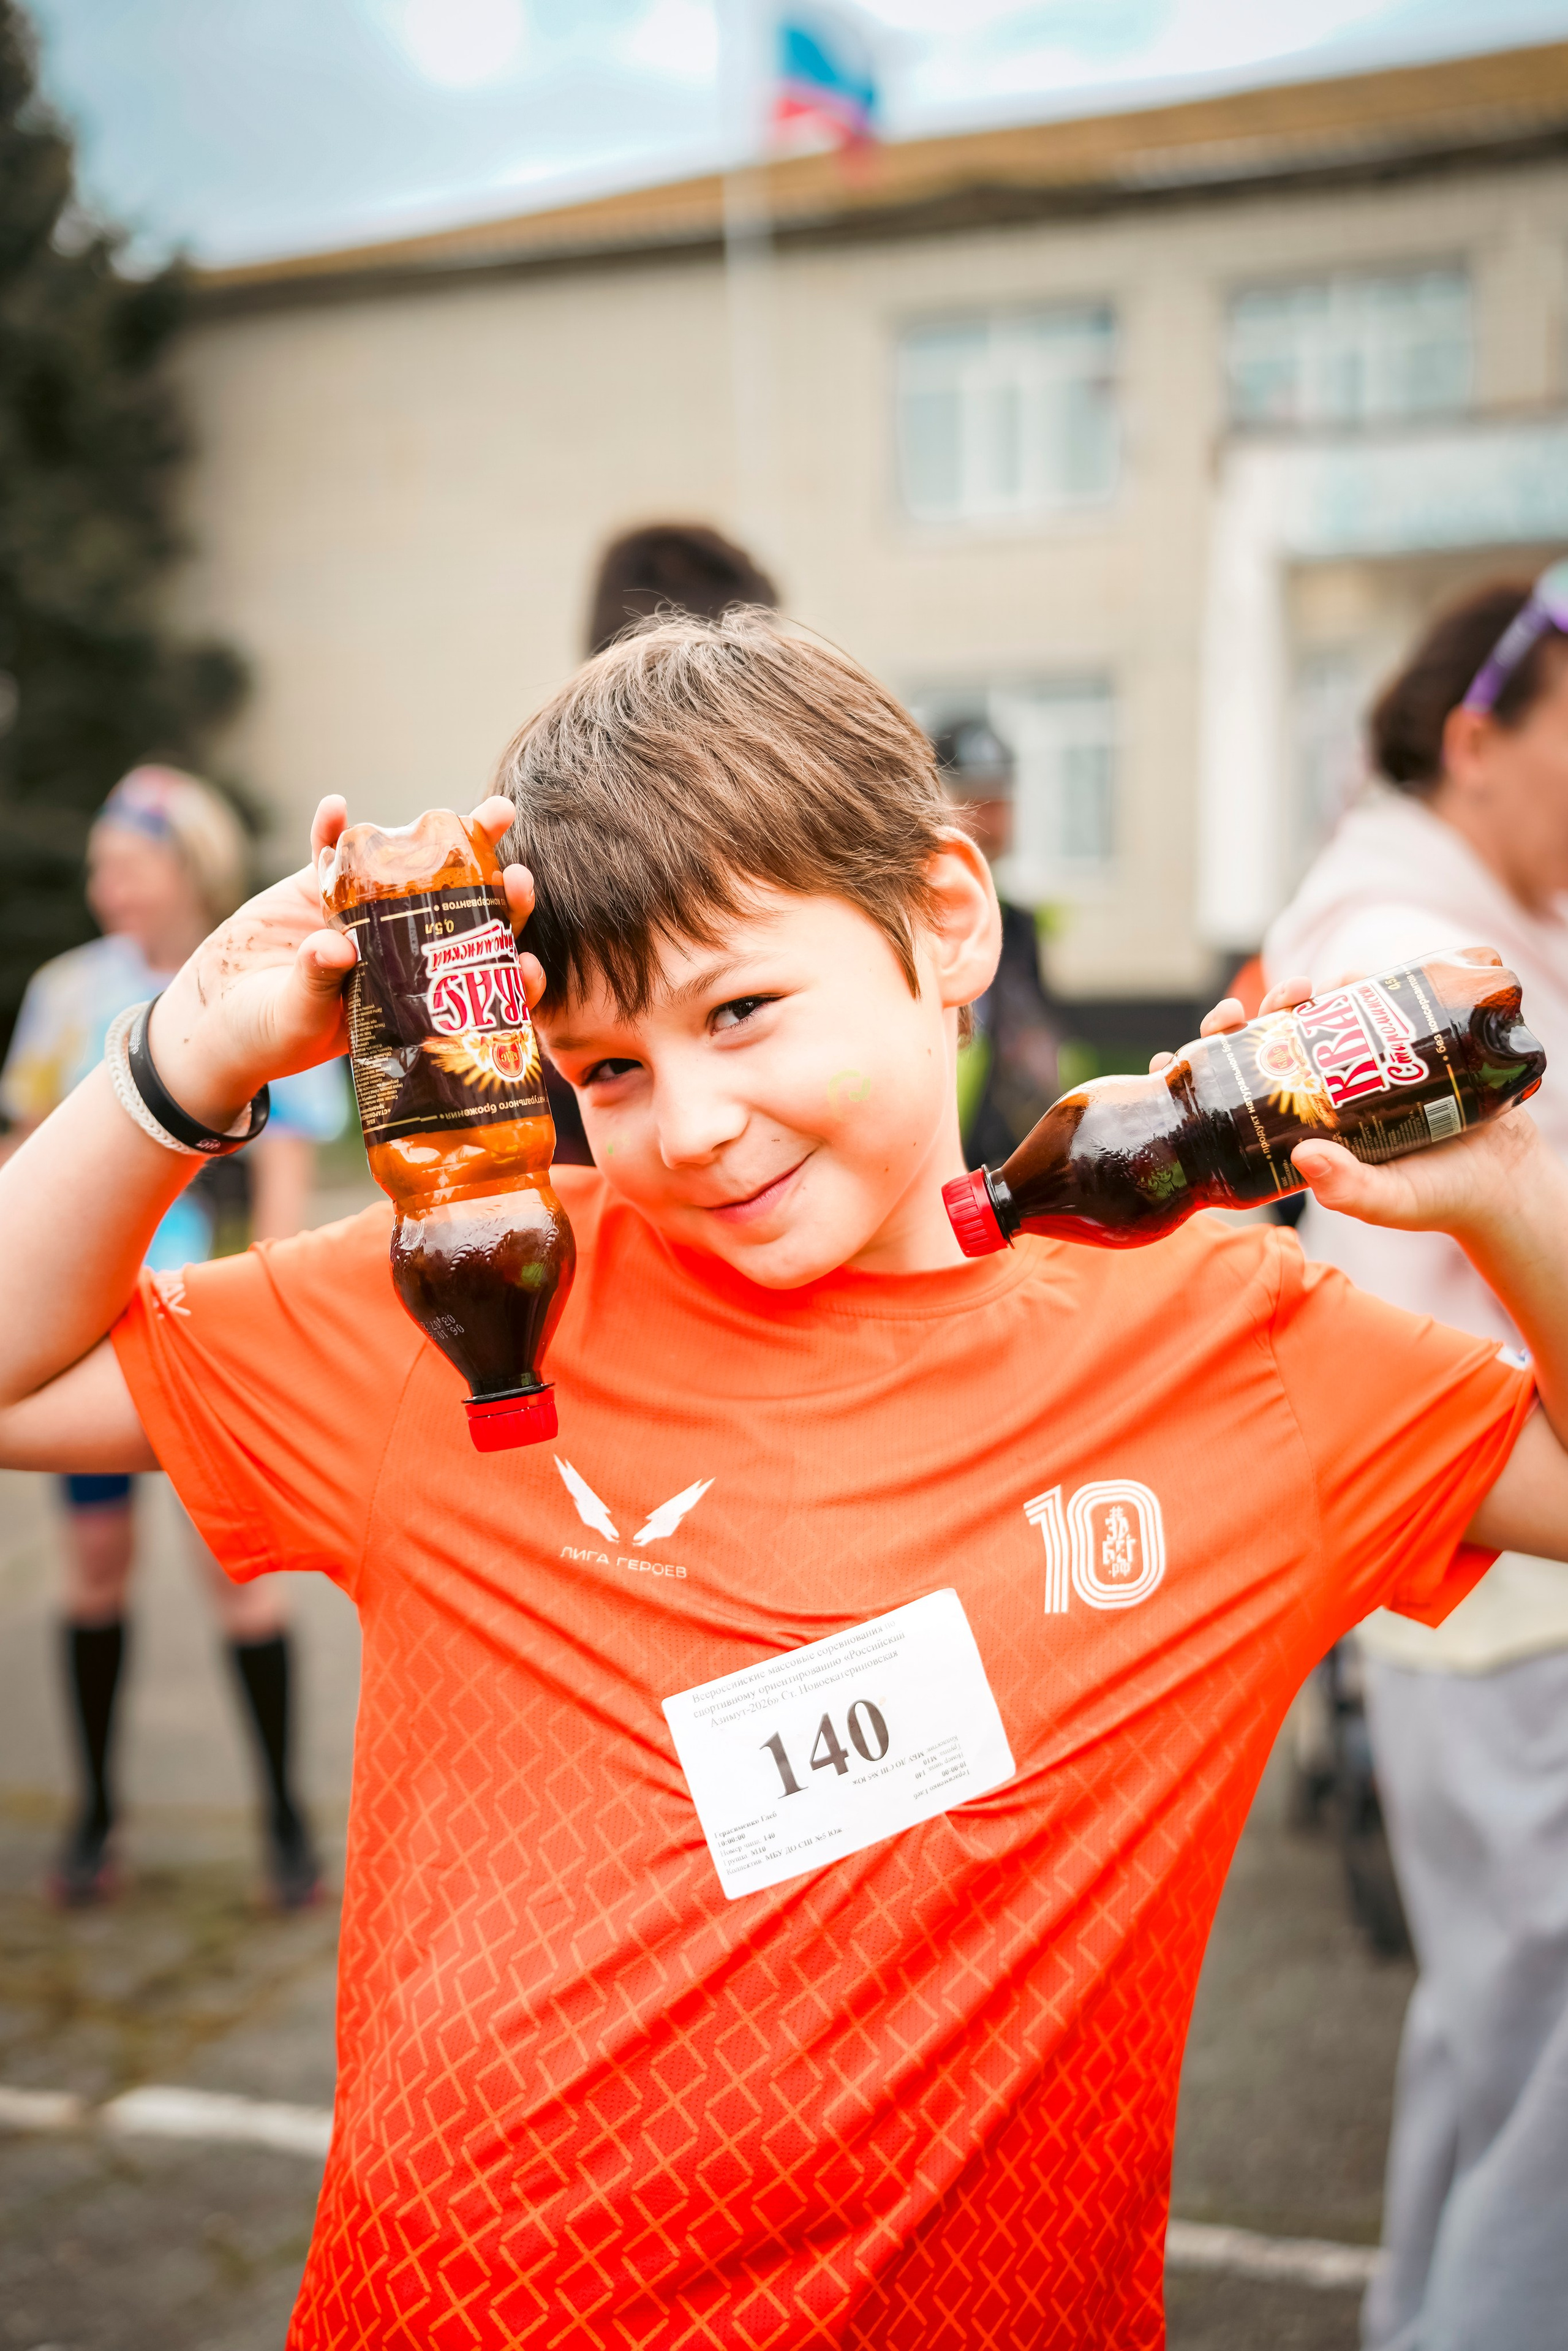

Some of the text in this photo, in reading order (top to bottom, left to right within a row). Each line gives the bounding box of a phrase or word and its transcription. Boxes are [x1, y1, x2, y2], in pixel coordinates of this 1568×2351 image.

[442, 895, 500, 911] консервантов
[432, 929, 518, 969] тароминский
[431, 970, 530, 1030] КВАС
[1407, 975, 1447, 1054] без консервантов
[1294, 994, 1385, 1108] КВАС
[1227, 1052, 1256, 1114] натурального
[445, 1095, 546, 1122] натурального брожения
[1250, 1114, 1271, 1154] продукт
[1023, 1479, 1166, 1615] 10
[560, 1545, 688, 1579] ЛИГА ГЕРОЕВ
[692, 1621, 895, 1704] Всероссийские массовые соревнования по
[693, 1632, 905, 1718] спортивному ориентированию «Российский
[711, 1650, 899, 1728] Азимут-2026» Ст. Новоекатериновская
[759, 1698, 889, 1799] 140
[895, 1757, 906, 1768] ДО
[908, 1750, 925, 1763] МБУ
[922, 1754, 938, 1766] М10
[944, 1751, 964, 1764] Номер
[867, 1770, 879, 1781] №5
[880, 1764, 894, 1775] СШ
[914, 1769, 926, 1779] 140
[941, 1760, 967, 1777] 10:00:00
[913, 1768, 970, 1800] Герасименко Глеб
[714, 1810, 777, 1839] Герасименко Глеб
[717, 1833, 746, 1848] 10:00:00
[720, 1846, 742, 1857] Номер
[763, 1832, 776, 1842] 140
[750, 1846, 767, 1857] М10
[764, 1849, 783, 1862] МБУ
[785, 1844, 797, 1855] ДО
[797, 1838, 813, 1849] СШ
[814, 1832, 827, 1843] №5
